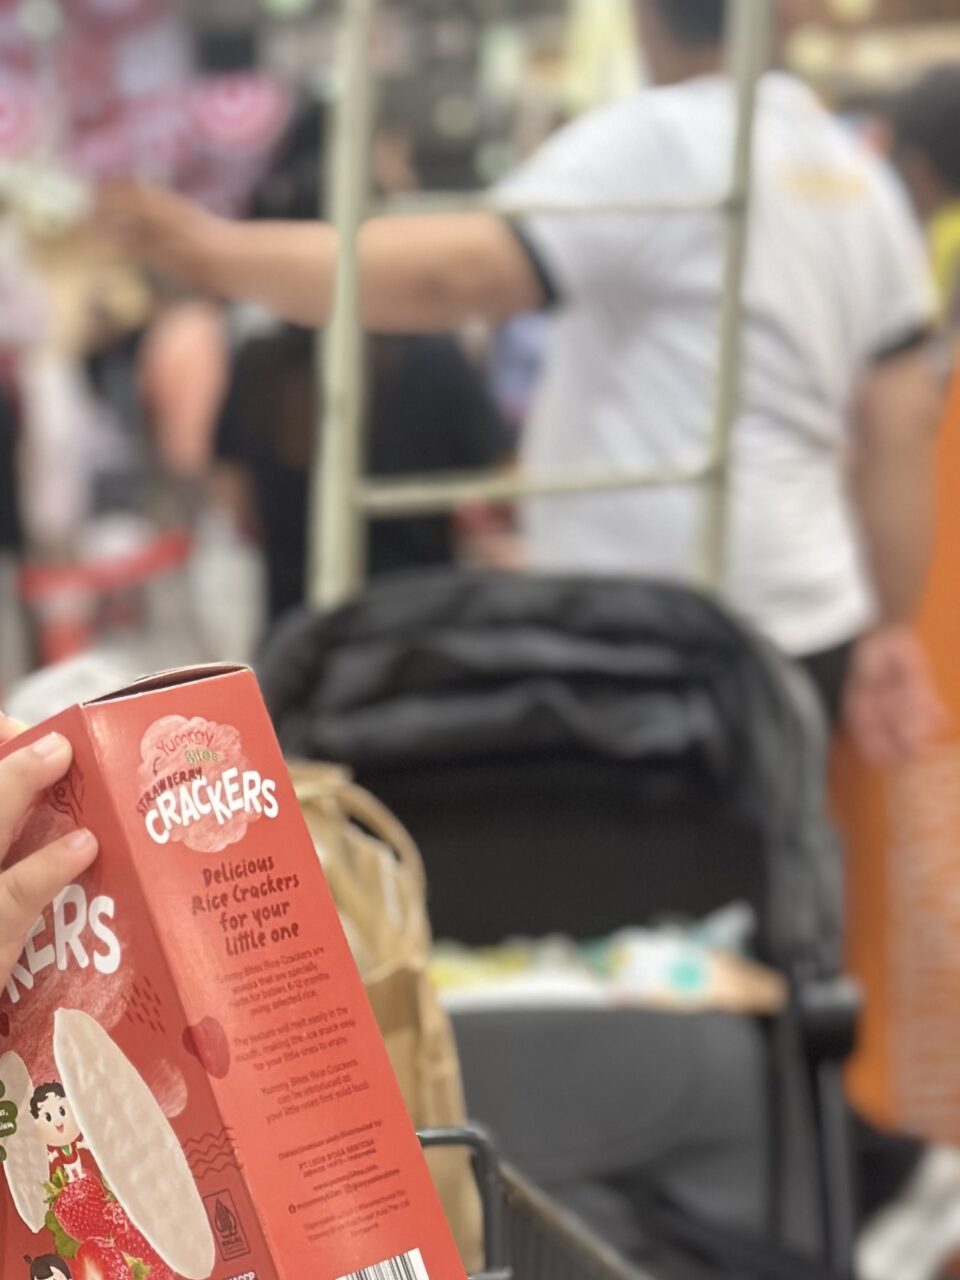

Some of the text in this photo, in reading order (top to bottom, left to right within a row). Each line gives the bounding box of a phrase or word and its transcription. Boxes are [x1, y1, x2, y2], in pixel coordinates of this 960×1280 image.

[137, 767, 202, 816] STRAWBERRY
[145, 767, 279, 844] CRACKERS
[202, 856, 274, 887] Delicious
[192, 874, 299, 916] Rice Crackers
[219, 902, 290, 932] for your
[271, 922, 299, 943] one
